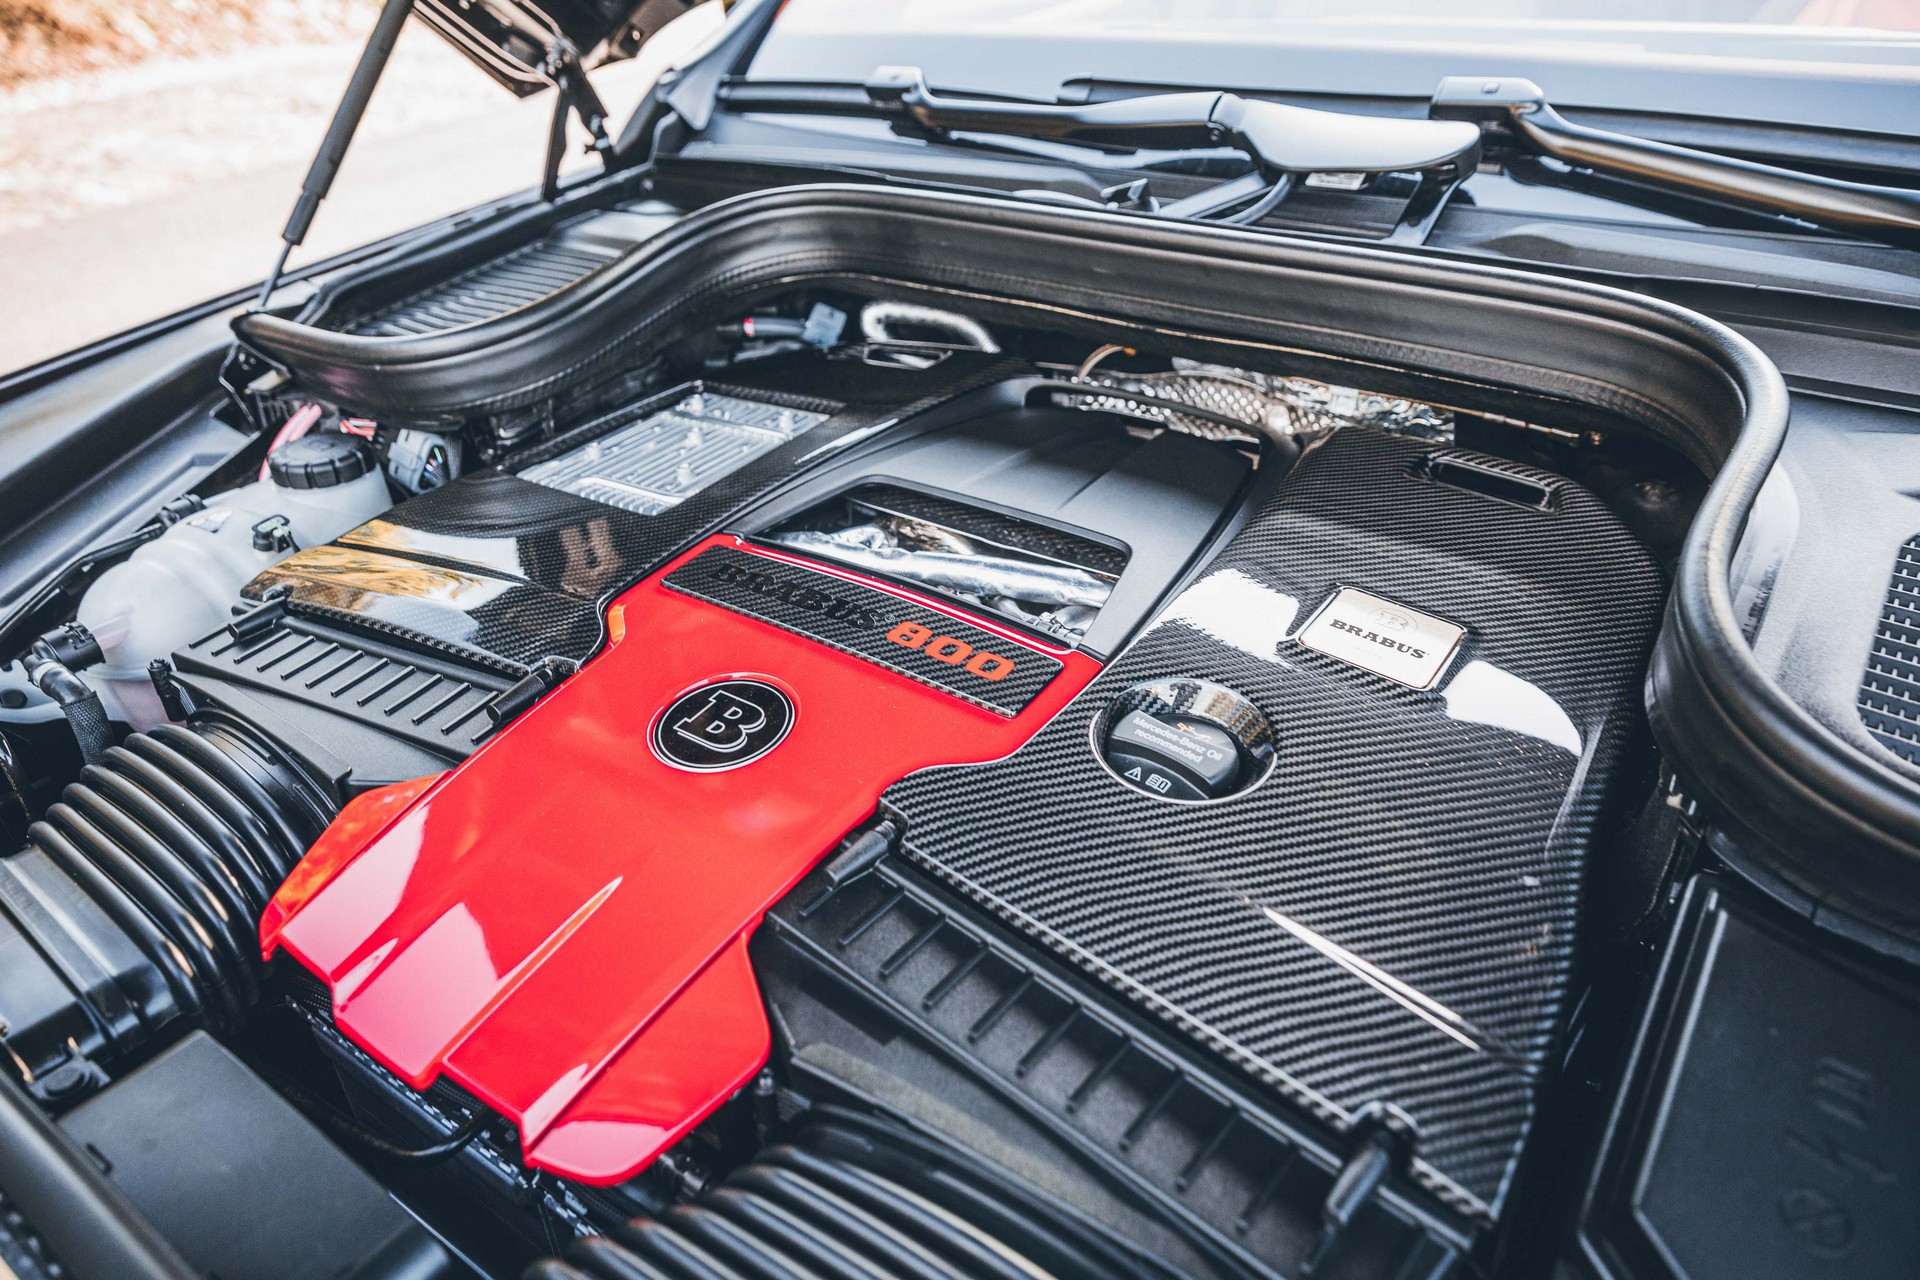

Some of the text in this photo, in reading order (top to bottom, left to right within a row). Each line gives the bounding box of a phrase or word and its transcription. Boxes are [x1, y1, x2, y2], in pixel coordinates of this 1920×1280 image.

[885, 620, 1015, 681] 800
[1329, 618, 1427, 659] BRABUS
[673, 690, 767, 753] B
[1132, 716, 1224, 761] Mercedes-Benz Oil
[1134, 728, 1204, 763] recommended
